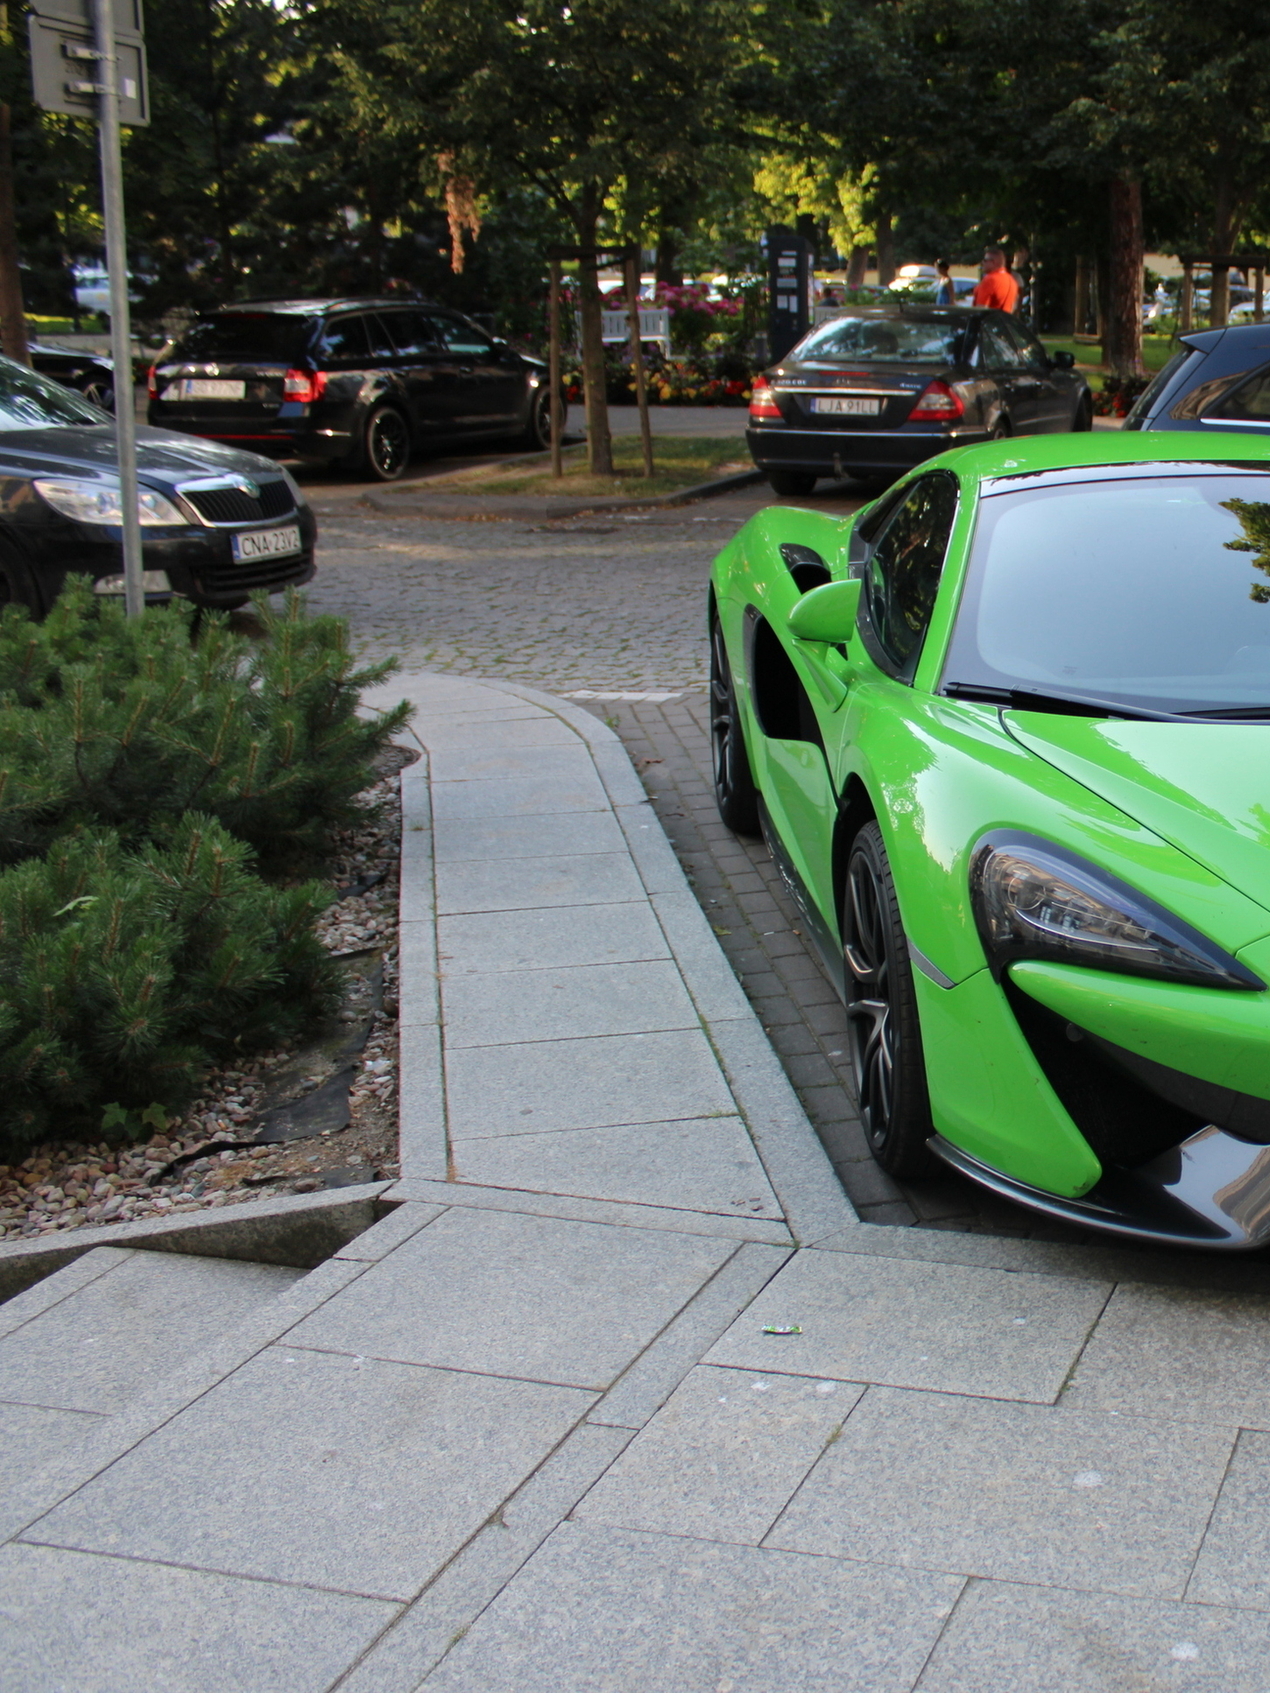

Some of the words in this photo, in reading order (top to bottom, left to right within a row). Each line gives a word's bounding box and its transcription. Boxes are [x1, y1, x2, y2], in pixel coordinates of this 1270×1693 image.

[818, 400, 843, 412] LJA
[847, 401, 876, 414] 91LL
[242, 535, 270, 556] CNA
[273, 529, 299, 552] 23V2
